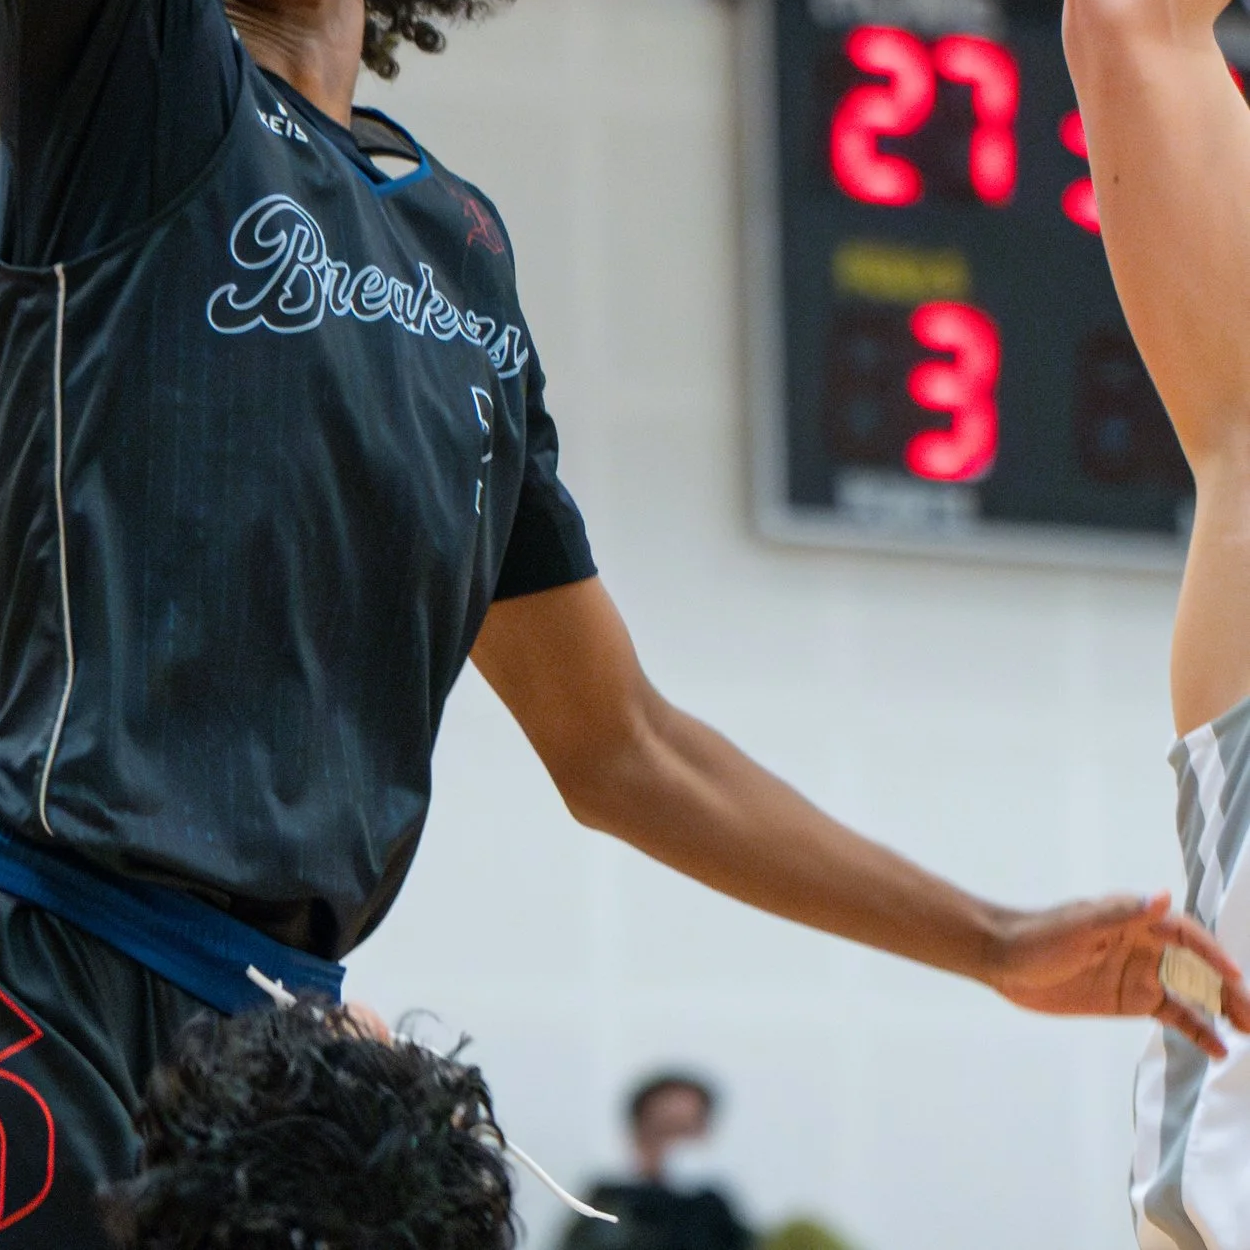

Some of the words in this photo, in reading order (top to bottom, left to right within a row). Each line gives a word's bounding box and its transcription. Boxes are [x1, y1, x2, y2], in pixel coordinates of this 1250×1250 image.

[828, 23, 1021, 209] 27
[206, 193, 530, 381] Breakers
[904, 298, 1002, 482] 3
